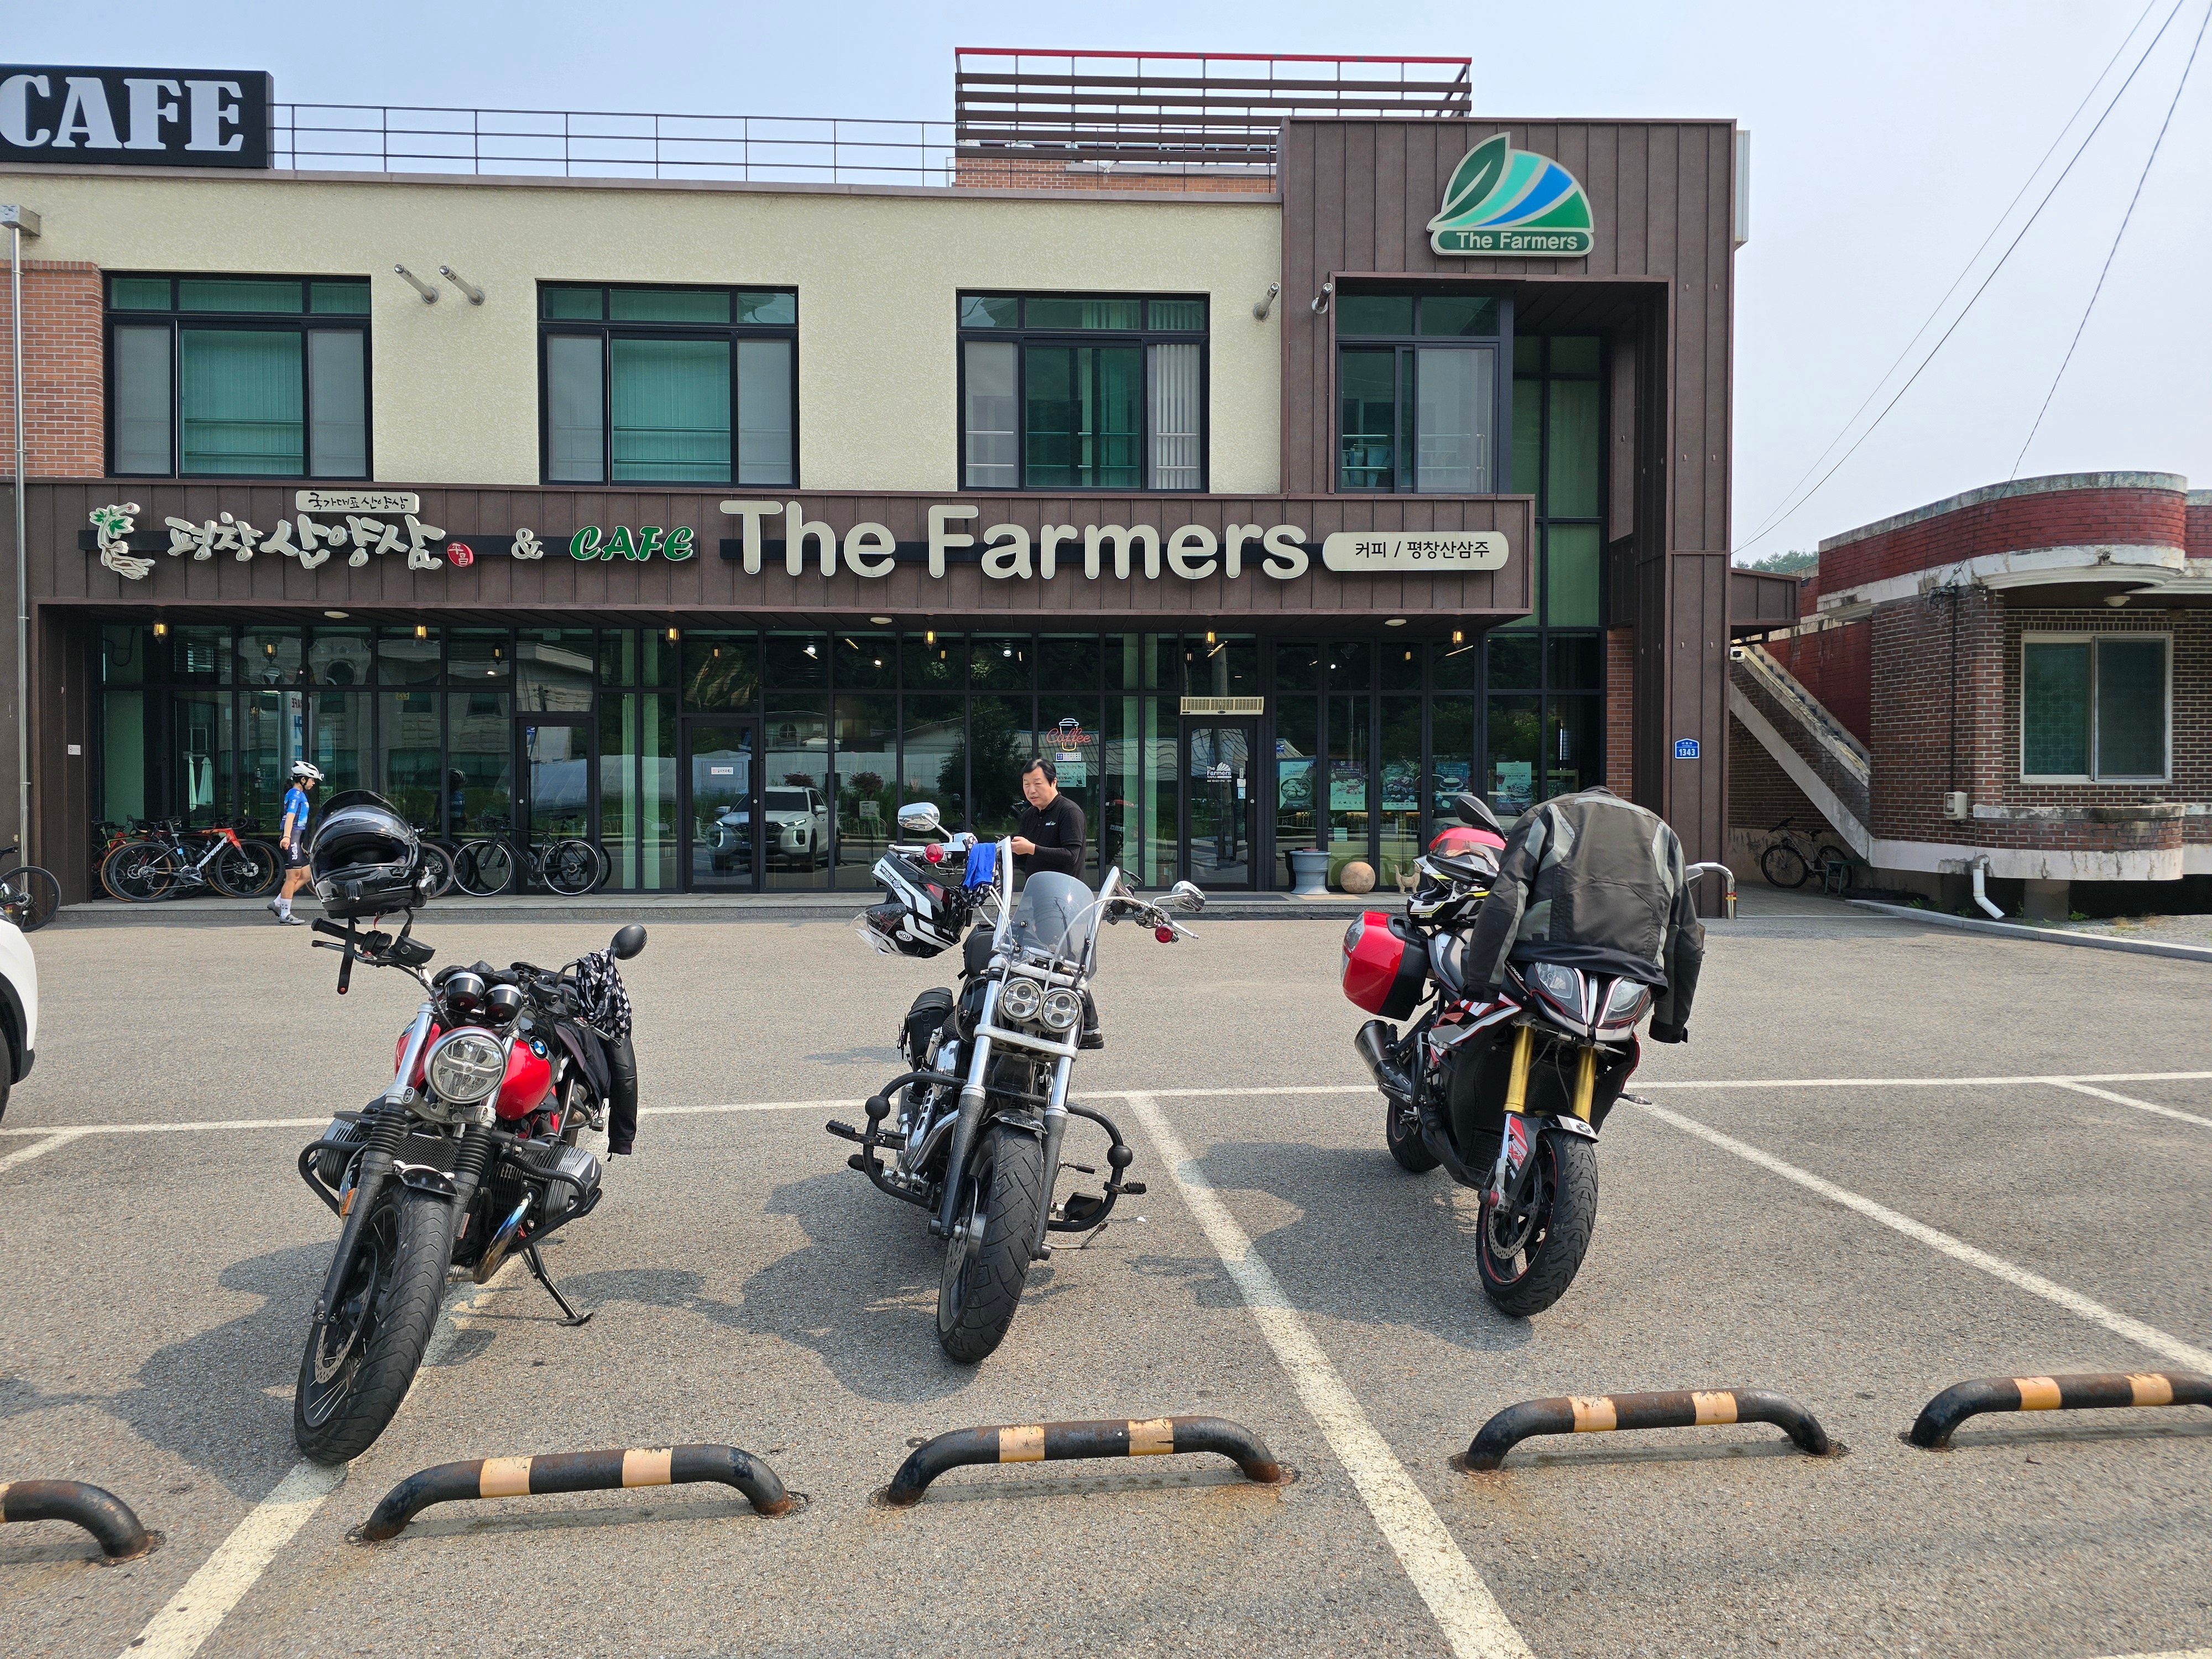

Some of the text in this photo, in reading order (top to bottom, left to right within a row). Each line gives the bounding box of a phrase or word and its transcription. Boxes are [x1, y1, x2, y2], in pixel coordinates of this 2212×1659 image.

[0, 74, 244, 152] CAFE
[1456, 232, 1578, 249] The Farmers
[308, 492, 409, 510] 국가대표 산양삼
[512, 525, 694, 561] & CAFE
[719, 500, 1310, 580] The Farmers
[1355, 541, 1386, 558] 커피
[1407, 541, 1490, 559] 평창산삼주
[1046, 728, 1092, 747] Coffee
[1678, 748, 1695, 757] 1343
[196, 836, 227, 870] MERIDA
[899, 932, 910, 940] ROK
[1505, 960, 1524, 981] S1000
